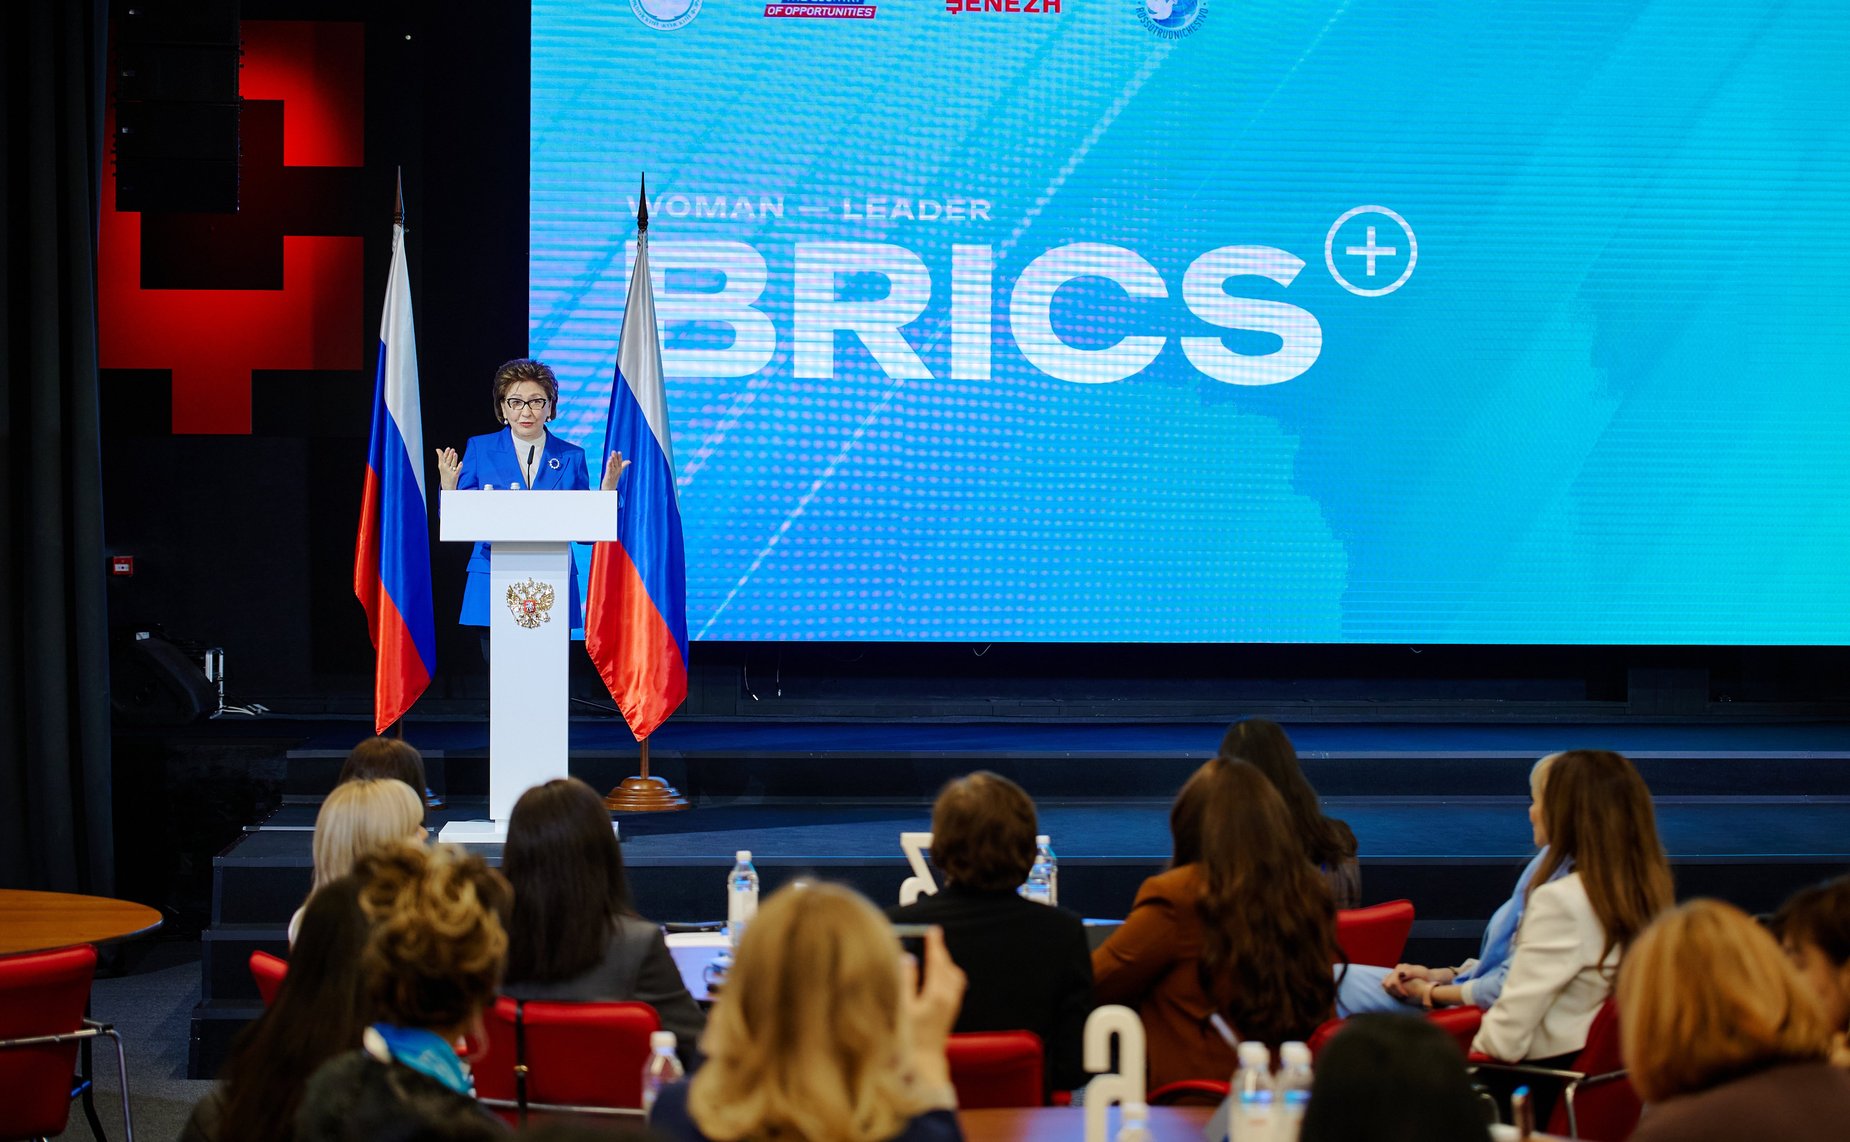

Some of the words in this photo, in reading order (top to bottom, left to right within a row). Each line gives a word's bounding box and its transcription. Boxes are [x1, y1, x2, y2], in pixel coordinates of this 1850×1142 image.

[767, 6, 783, 15] OF
[785, 6, 873, 17] OPPORTUNITIES
[1136, 7, 1209, 40] ROSSOTRUDNICHESTVO
[626, 195, 784, 218] WOMAN
[843, 198, 992, 221] LEADER
[625, 241, 1323, 386] BRICS
